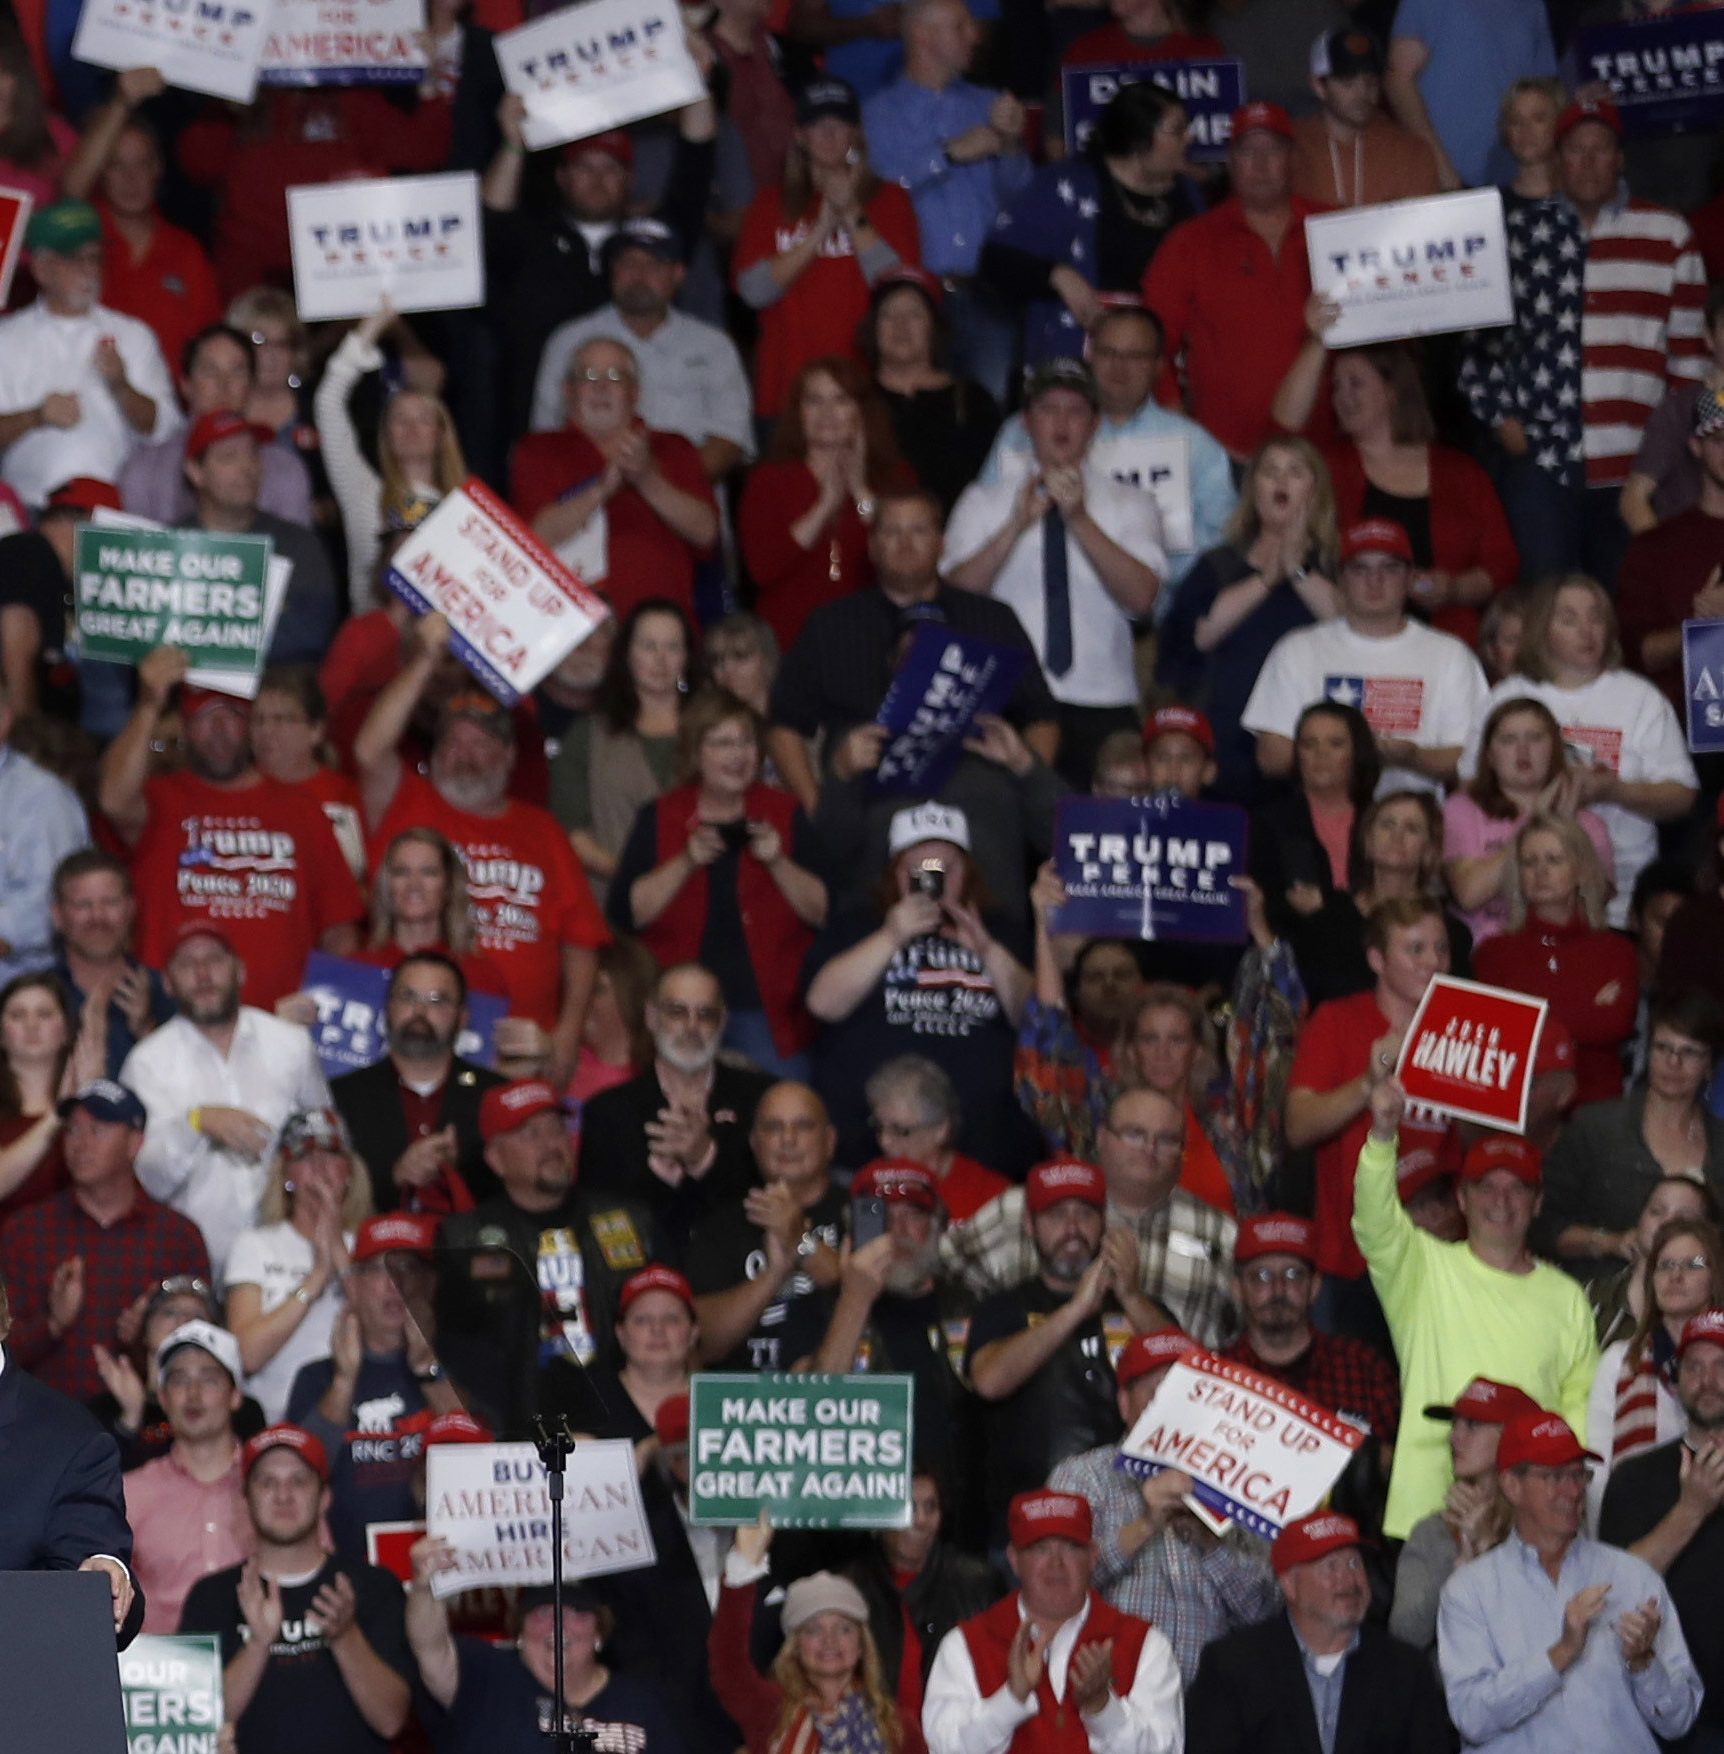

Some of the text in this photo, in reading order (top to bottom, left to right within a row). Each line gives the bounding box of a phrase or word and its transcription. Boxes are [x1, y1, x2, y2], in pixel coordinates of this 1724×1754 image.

[261, 37, 415, 62] AMERICA
[522, 20, 666, 78] TRUMP
[1589, 46, 1724, 82] TRUMP
[311, 216, 463, 247] TRUMP
[1329, 233, 1487, 275] TRUMP
[98, 547, 242, 578] MAKE OUR
[458, 514, 532, 588] STAND
[82, 576, 259, 612] FARMERS
[408, 552, 530, 671] AMERICA
[80, 613, 258, 650] GREAT AGAIN!
[1069, 835, 1232, 866] TRUMP
[1415, 1033, 1518, 1090] HAWLEY
[722, 1396, 881, 1427] MAKE OUR
[1187, 1380, 1320, 1458] STAND UP
[697, 1430, 903, 1467] FARMERS
[493, 1459, 548, 1484] BUY
[695, 1469, 907, 1500] GREAT AGAIN!
[1141, 1427, 1292, 1515] AMERICA
